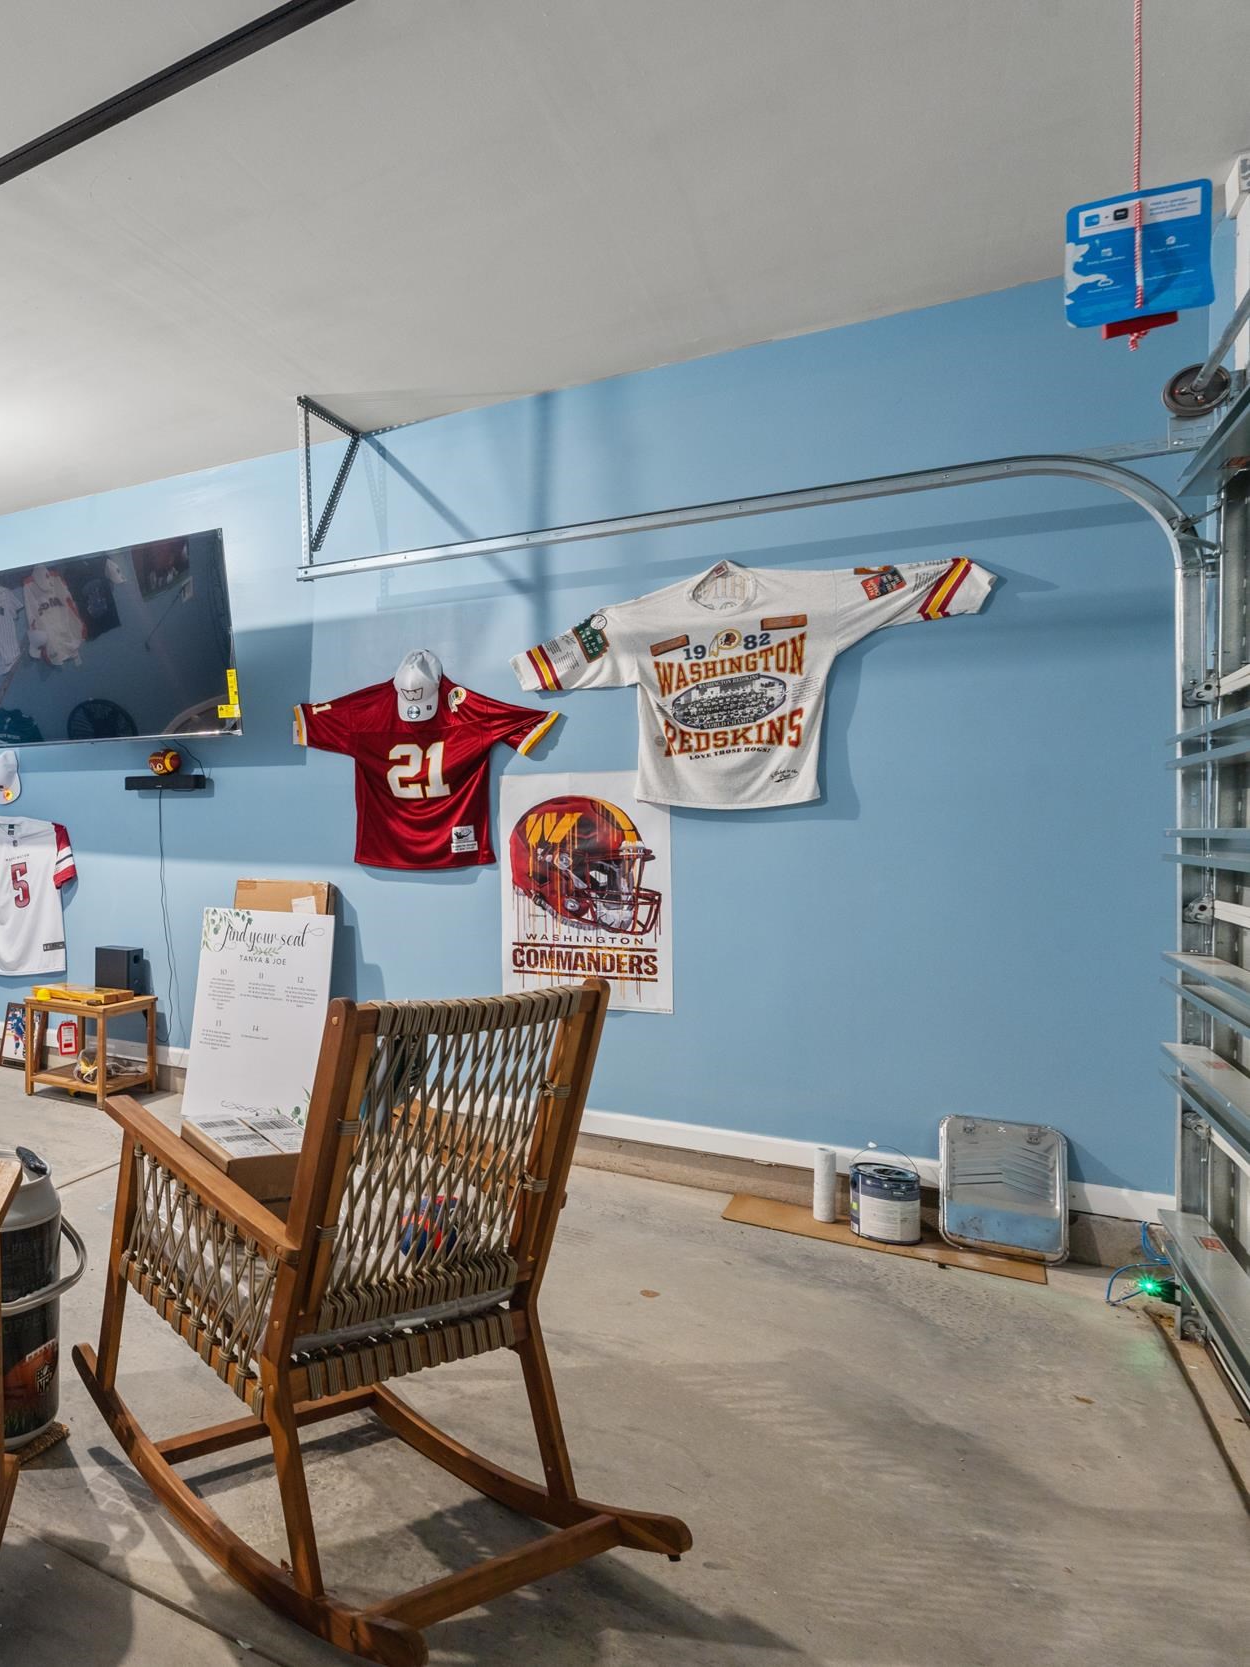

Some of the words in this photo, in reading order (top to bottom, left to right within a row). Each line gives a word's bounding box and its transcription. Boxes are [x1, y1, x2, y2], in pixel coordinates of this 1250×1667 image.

[683, 644, 706, 661] 19
[743, 632, 771, 650] 82
[653, 631, 807, 698] WASHINGTON
[664, 707, 804, 757] REDSKINS
[714, 748, 742, 756] THOSE
[387, 741, 451, 799] 21
[11, 862, 30, 908] 5
[216, 920, 250, 952] find
[248, 931, 279, 952] your
[526, 932, 645, 946] WASHINGTON
[239, 954, 263, 964] TANYA
[272, 958, 287, 966] JOE
[512, 947, 659, 976] COMMANDERS
